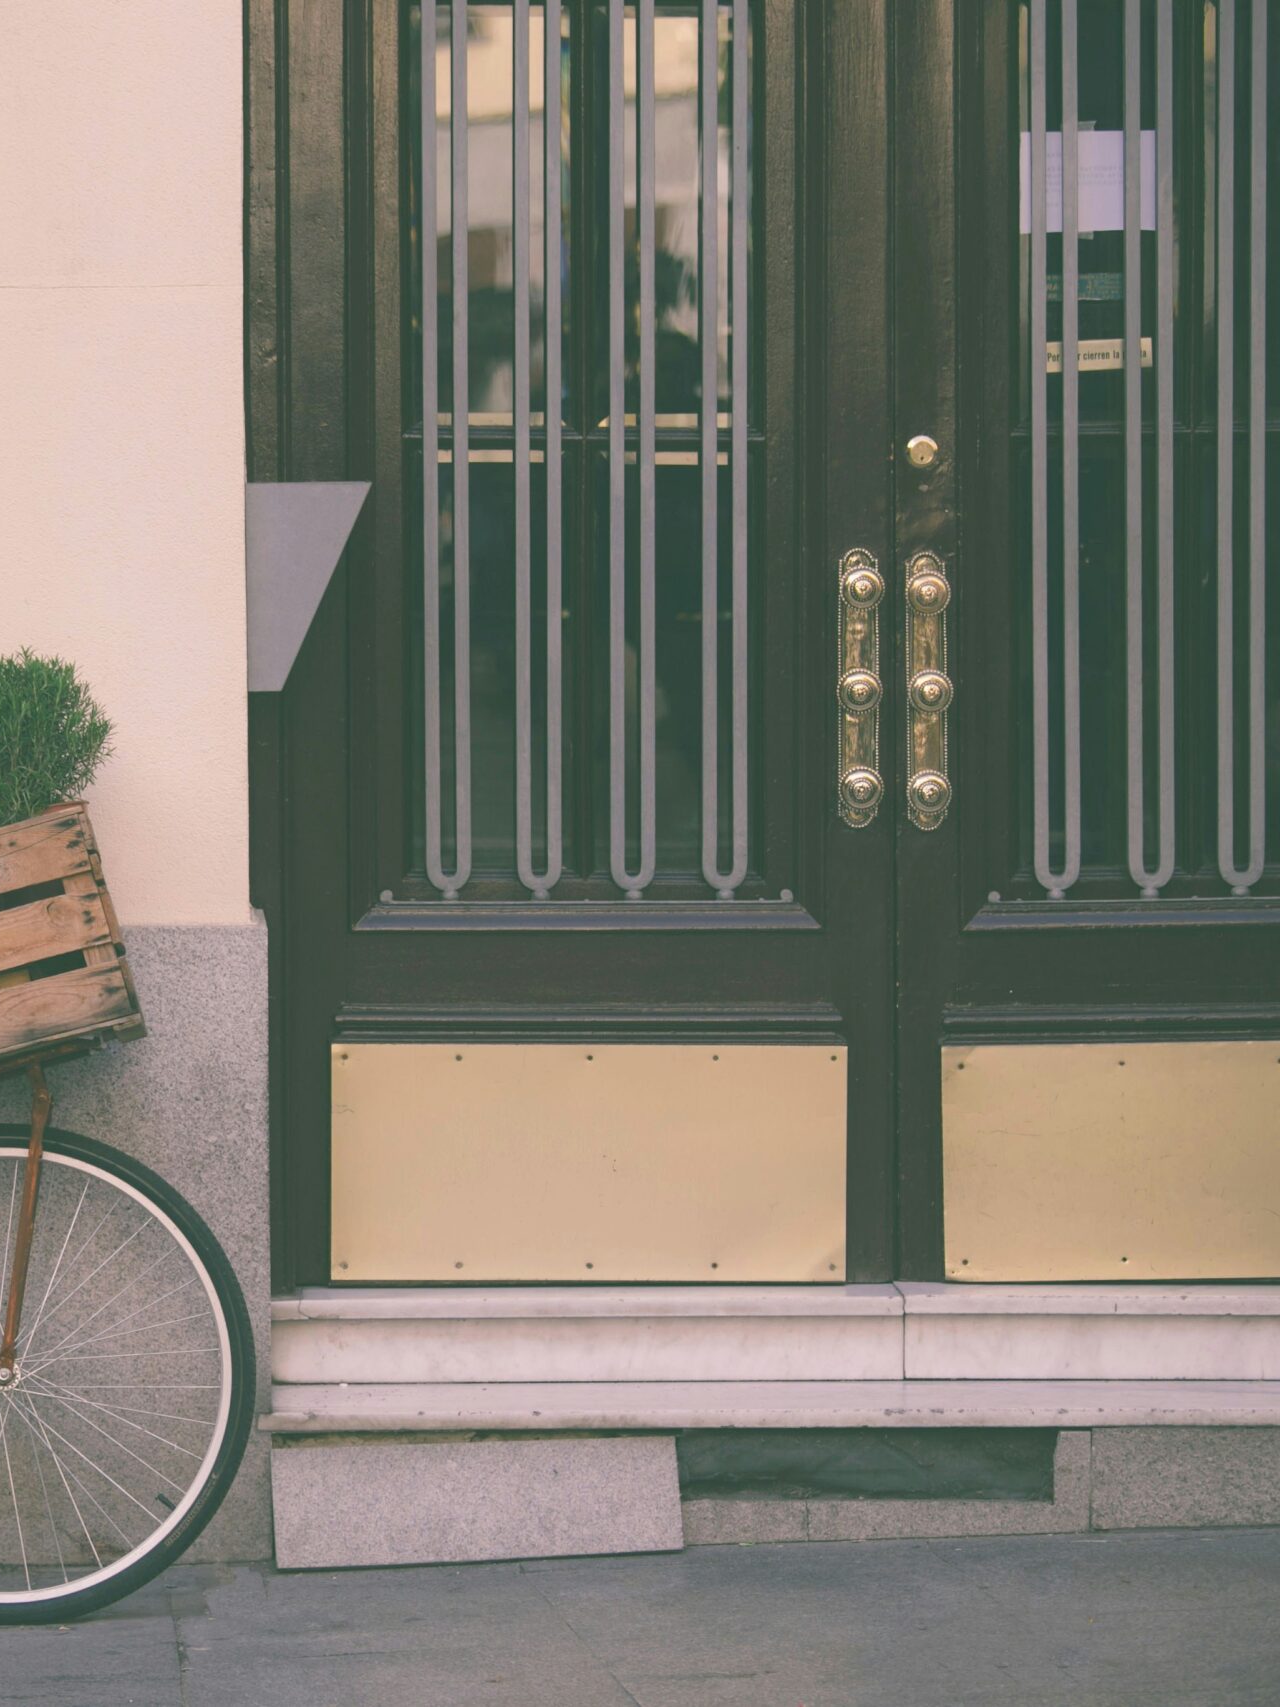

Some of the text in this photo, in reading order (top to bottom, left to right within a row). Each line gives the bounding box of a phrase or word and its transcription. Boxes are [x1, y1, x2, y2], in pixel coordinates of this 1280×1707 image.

[1047, 352, 1060, 363] Por
[1083, 351, 1110, 361] cierren
[1113, 350, 1120, 359] la
